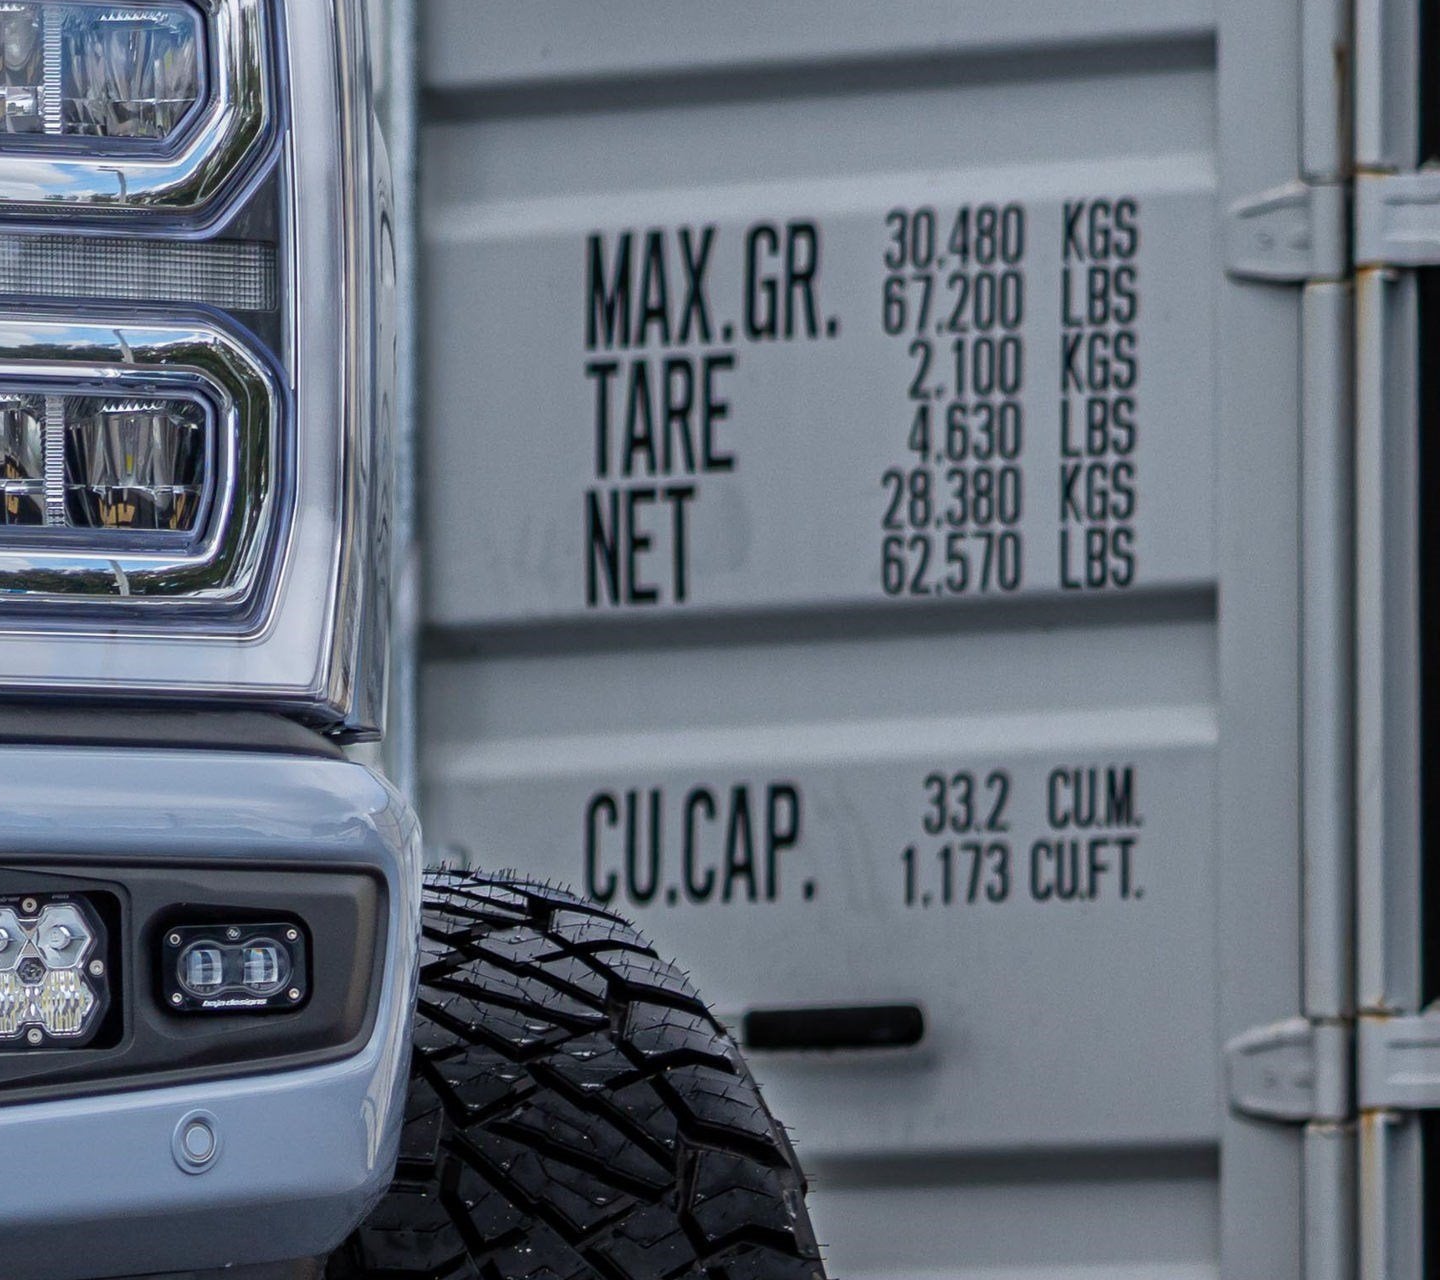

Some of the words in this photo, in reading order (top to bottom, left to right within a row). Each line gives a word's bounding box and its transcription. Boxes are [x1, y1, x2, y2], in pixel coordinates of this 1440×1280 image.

[1061, 197, 1142, 262] KGS
[586, 220, 839, 351] MAX.GR.
[1061, 263, 1139, 329] LBS
[1061, 330, 1138, 395] KGS
[585, 353, 737, 479] TARE
[1060, 396, 1138, 459] LBS
[1060, 461, 1137, 523] KGS
[585, 484, 695, 608] NET
[1060, 527, 1136, 591] LBS
[923, 768, 1012, 836] 33.2
[585, 781, 817, 908] CU.CAP.
